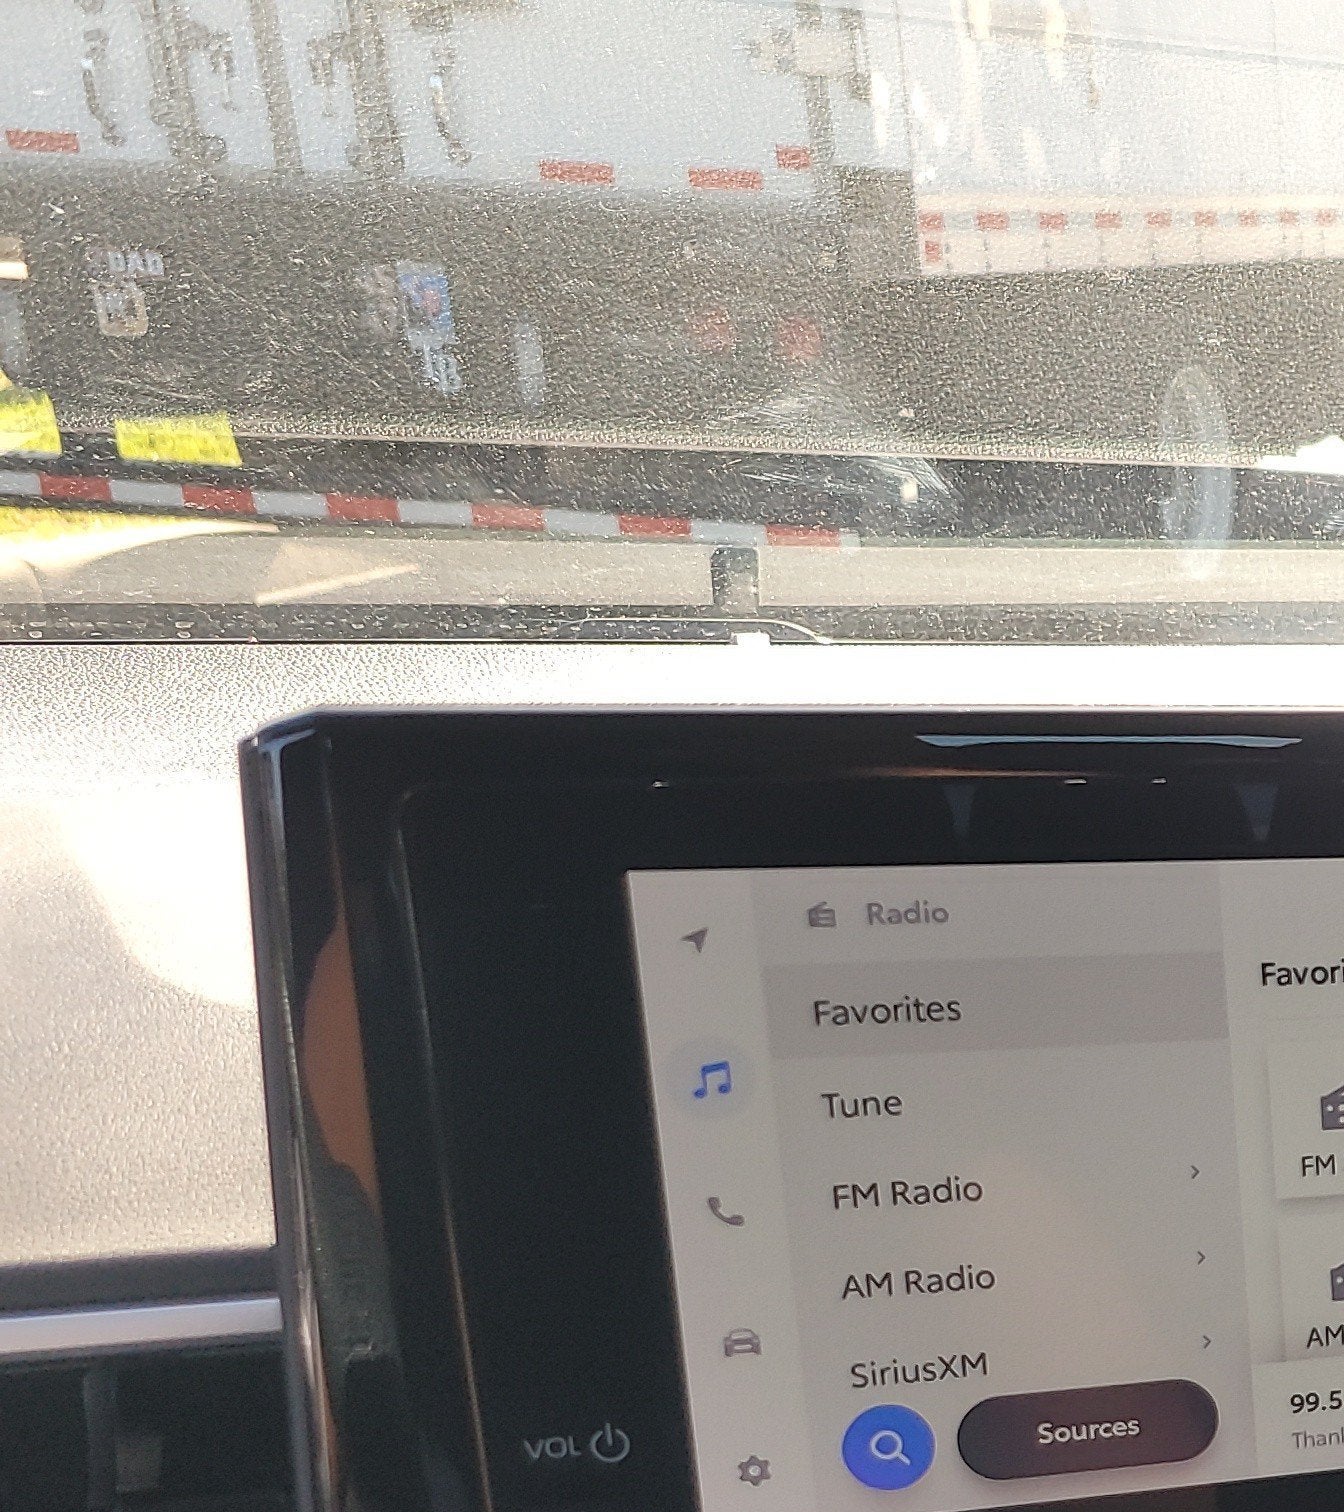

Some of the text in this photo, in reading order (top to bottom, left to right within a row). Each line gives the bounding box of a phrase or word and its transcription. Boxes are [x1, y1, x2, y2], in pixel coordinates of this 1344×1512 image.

[866, 900, 949, 925] Radio
[814, 996, 961, 1026] Favorites
[821, 1093, 902, 1118] Tune
[1302, 1154, 1335, 1177] FM
[833, 1176, 982, 1209] FM Radio
[842, 1265, 995, 1299] AM Radio
[1307, 1324, 1344, 1349] AM
[851, 1352, 987, 1388] SiriusXM
[1290, 1390, 1342, 1413] 99.5
[1037, 1416, 1141, 1447] Sources
[523, 1436, 582, 1461] VOL
